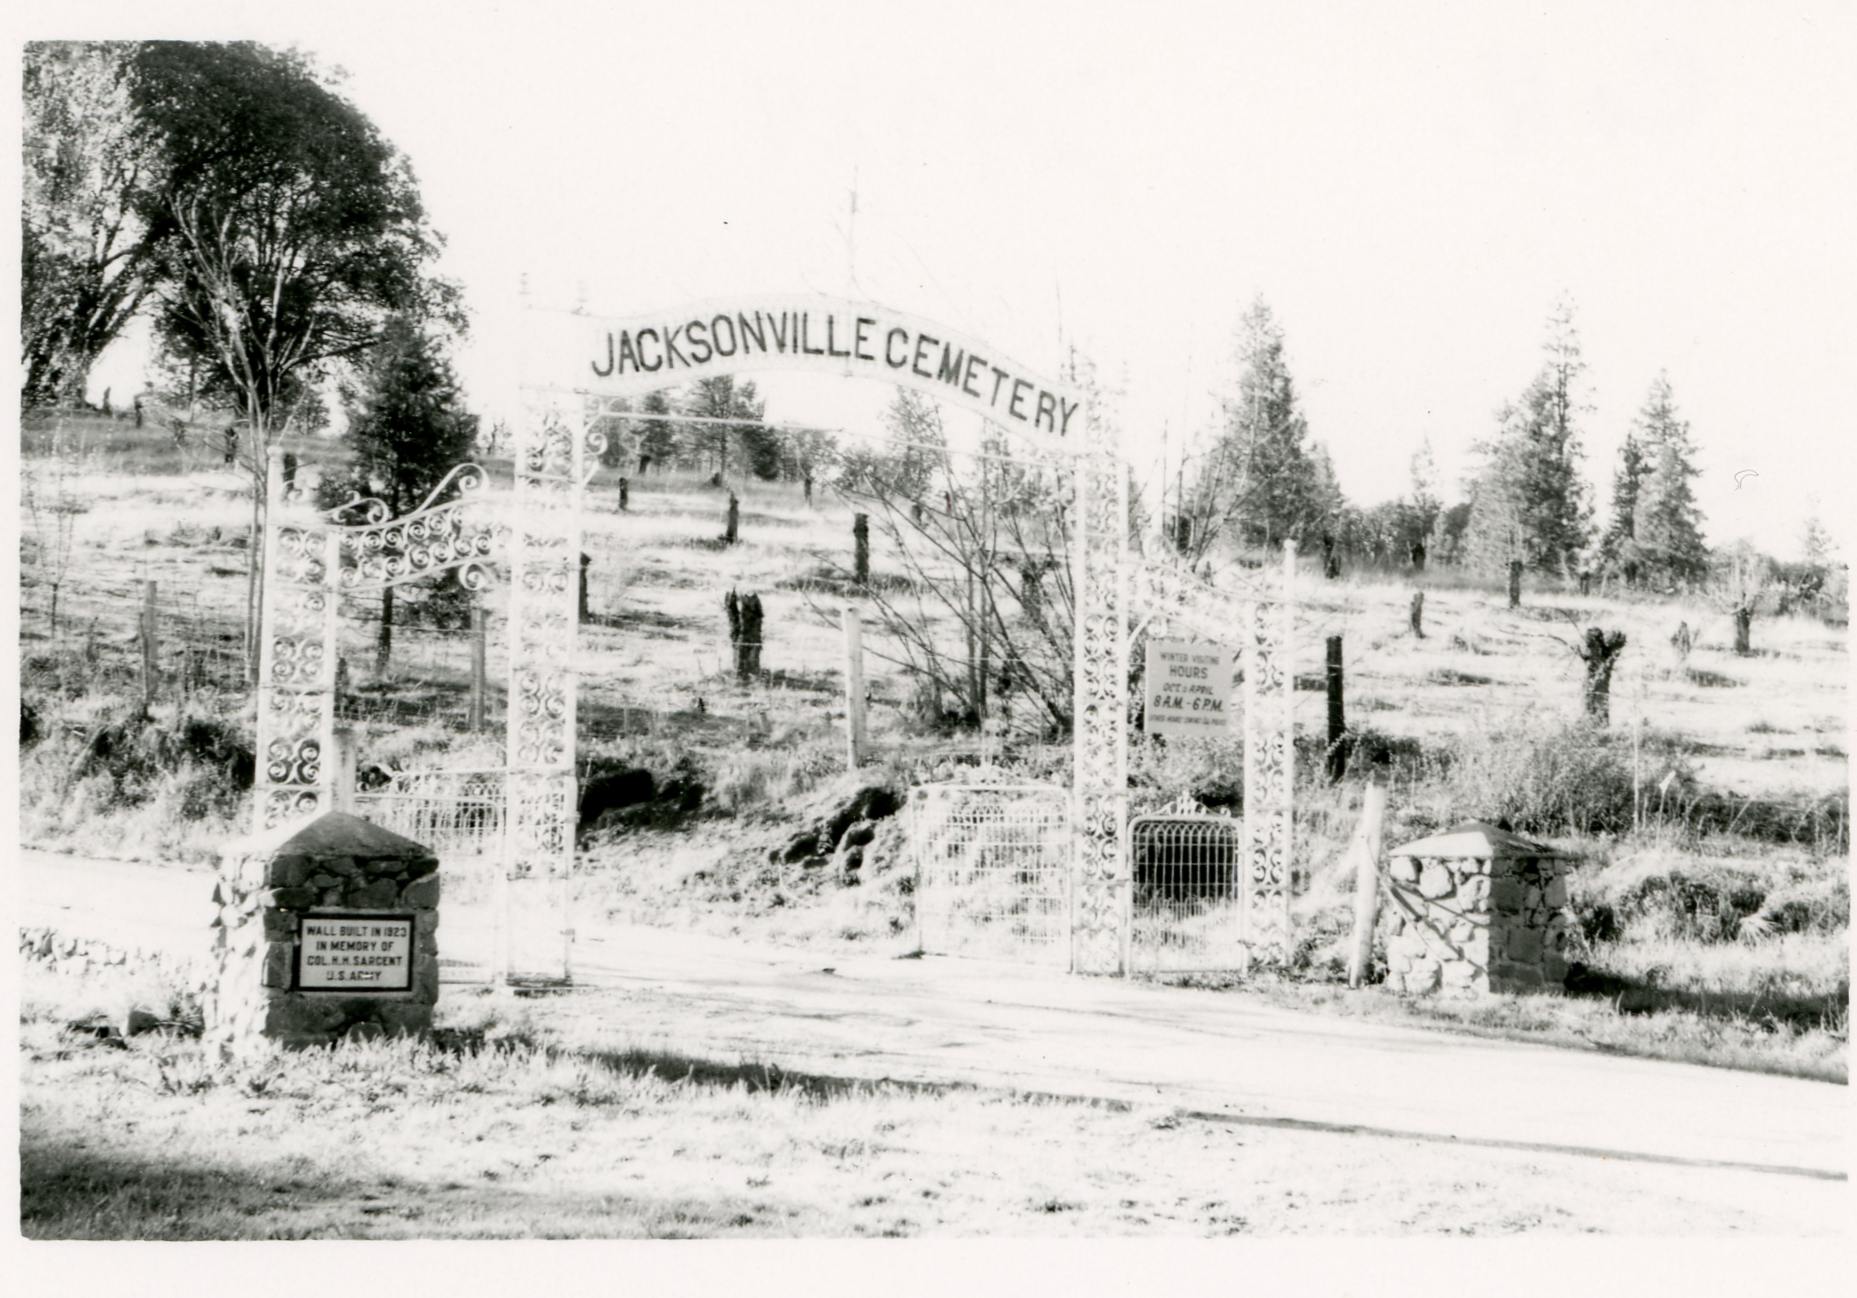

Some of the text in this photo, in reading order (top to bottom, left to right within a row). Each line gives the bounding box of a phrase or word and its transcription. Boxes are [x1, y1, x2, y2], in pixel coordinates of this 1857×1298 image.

[591, 310, 1080, 437] JACKSONVILLE CEMETERY
[1168, 665, 1208, 679] HOURS
[1192, 697, 1201, 711] 6
[306, 926, 337, 937] WALL
[339, 926, 368, 937] BUILT
[371, 927, 381, 937] IN
[316, 941, 395, 951] IN MEMORY OF
